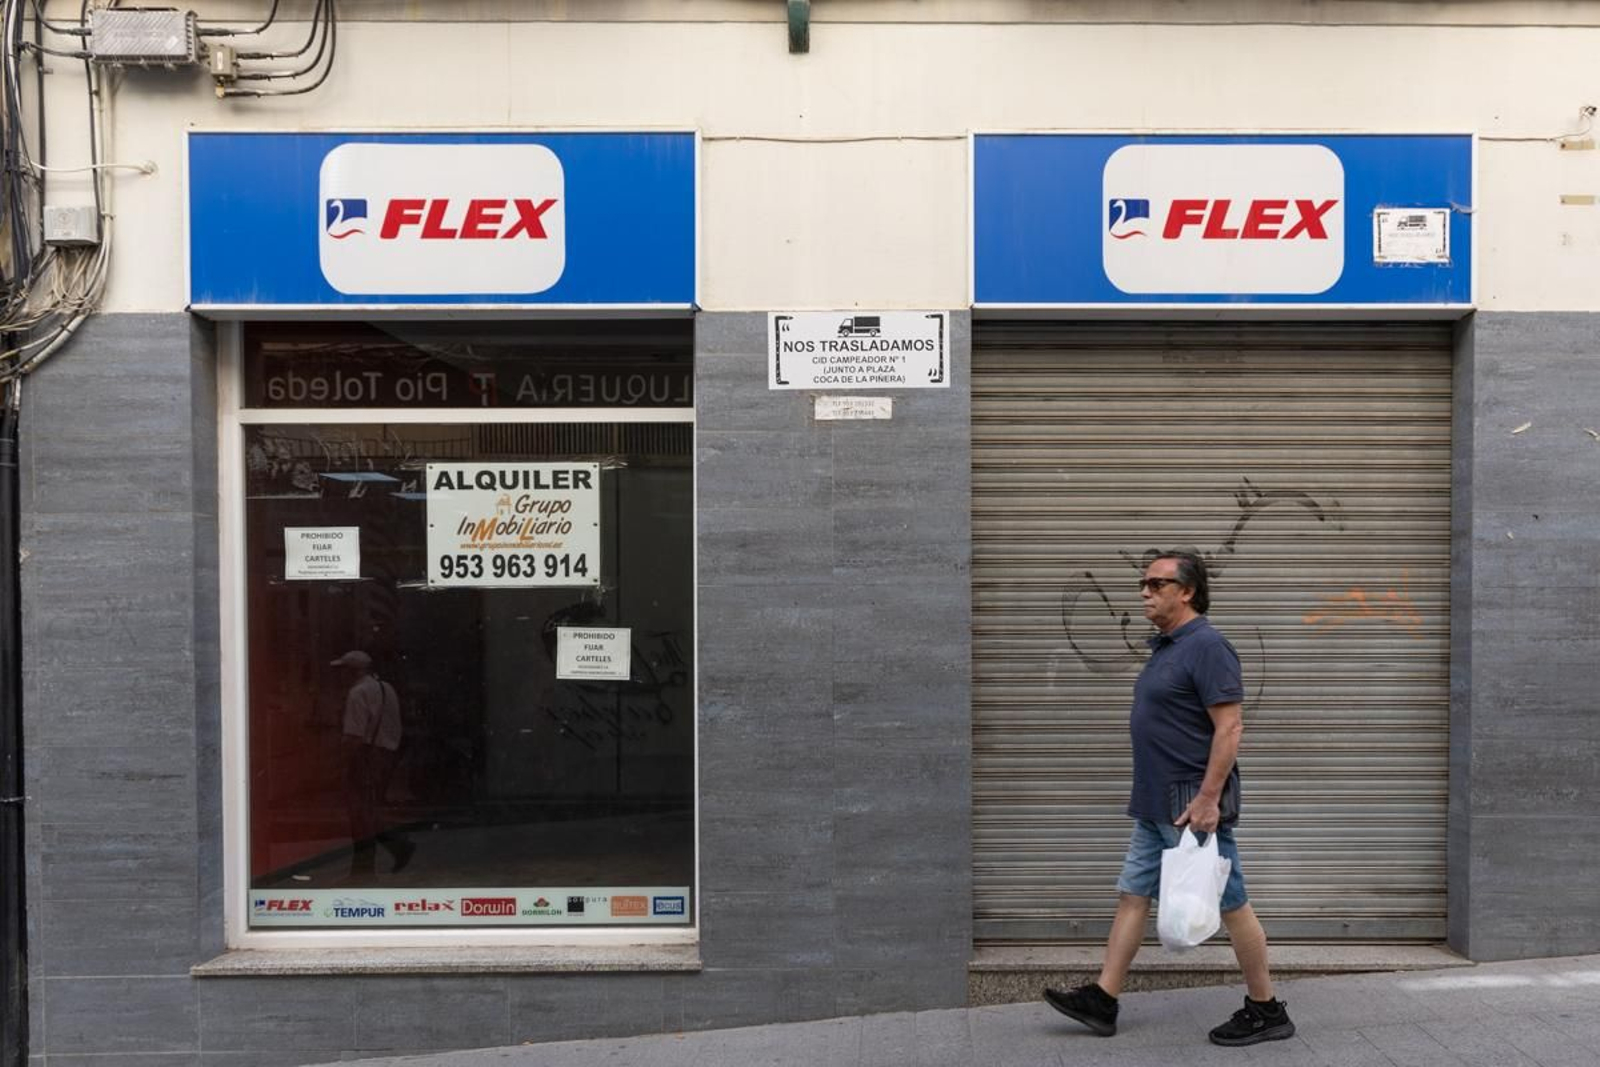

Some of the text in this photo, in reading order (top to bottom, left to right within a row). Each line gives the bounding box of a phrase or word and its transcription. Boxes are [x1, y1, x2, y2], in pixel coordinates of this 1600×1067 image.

[379, 199, 558, 239] FLEX
[1162, 199, 1339, 239] FLEX
[783, 339, 934, 353] NOS TRASLADAMOS
[829, 356, 887, 364] CAMPEADOR
[823, 366, 856, 374] (JUNTO
[866, 365, 895, 373] PLAZA
[433, 469, 592, 491] ALQUILER
[515, 494, 572, 517] Grupo
[300, 532, 344, 540] PROHIBIDO
[305, 555, 341, 563] CARTELES
[440, 553, 588, 579] 953 963 914
[573, 632, 616, 640] PROHIBIDO
[575, 655, 612, 663] CARTELES
[266, 899, 313, 911] FLEX
[394, 899, 455, 912] relax
[462, 900, 516, 914] Dorwin
[333, 907, 385, 918] TEMPUR
